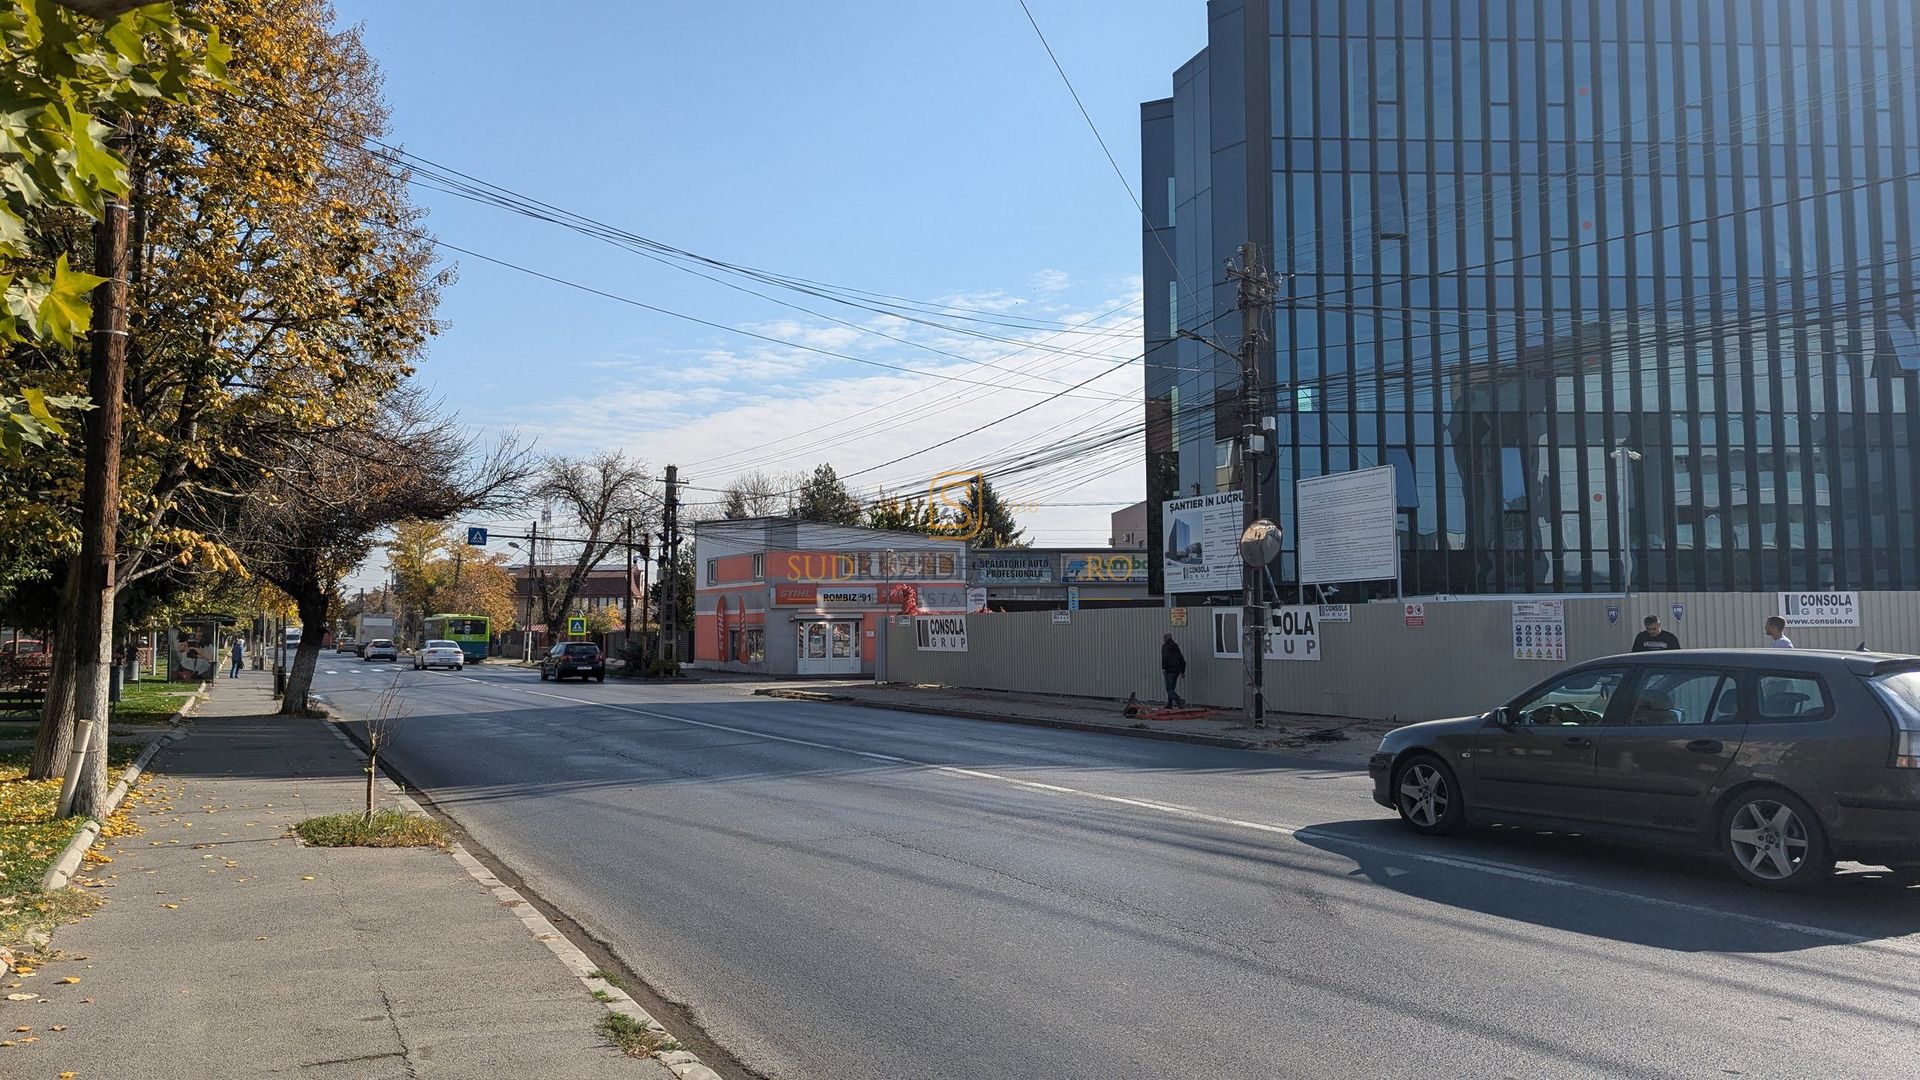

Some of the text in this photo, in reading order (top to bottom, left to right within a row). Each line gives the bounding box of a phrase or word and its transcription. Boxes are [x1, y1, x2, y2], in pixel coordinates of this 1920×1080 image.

[980, 560, 1049, 568] SPALATORIE AUTO
[986, 570, 1043, 578] PROFESIONALA
[781, 589, 811, 597] STIHL
[823, 593, 857, 602] ROMBIZ
[1801, 595, 1852, 606] CONSOLA
[1326, 604, 1348, 612] CONSOLA
[1801, 607, 1853, 615] GRUP
[930, 619, 965, 635] CONSOLA
[931, 637, 966, 648] GRUP
